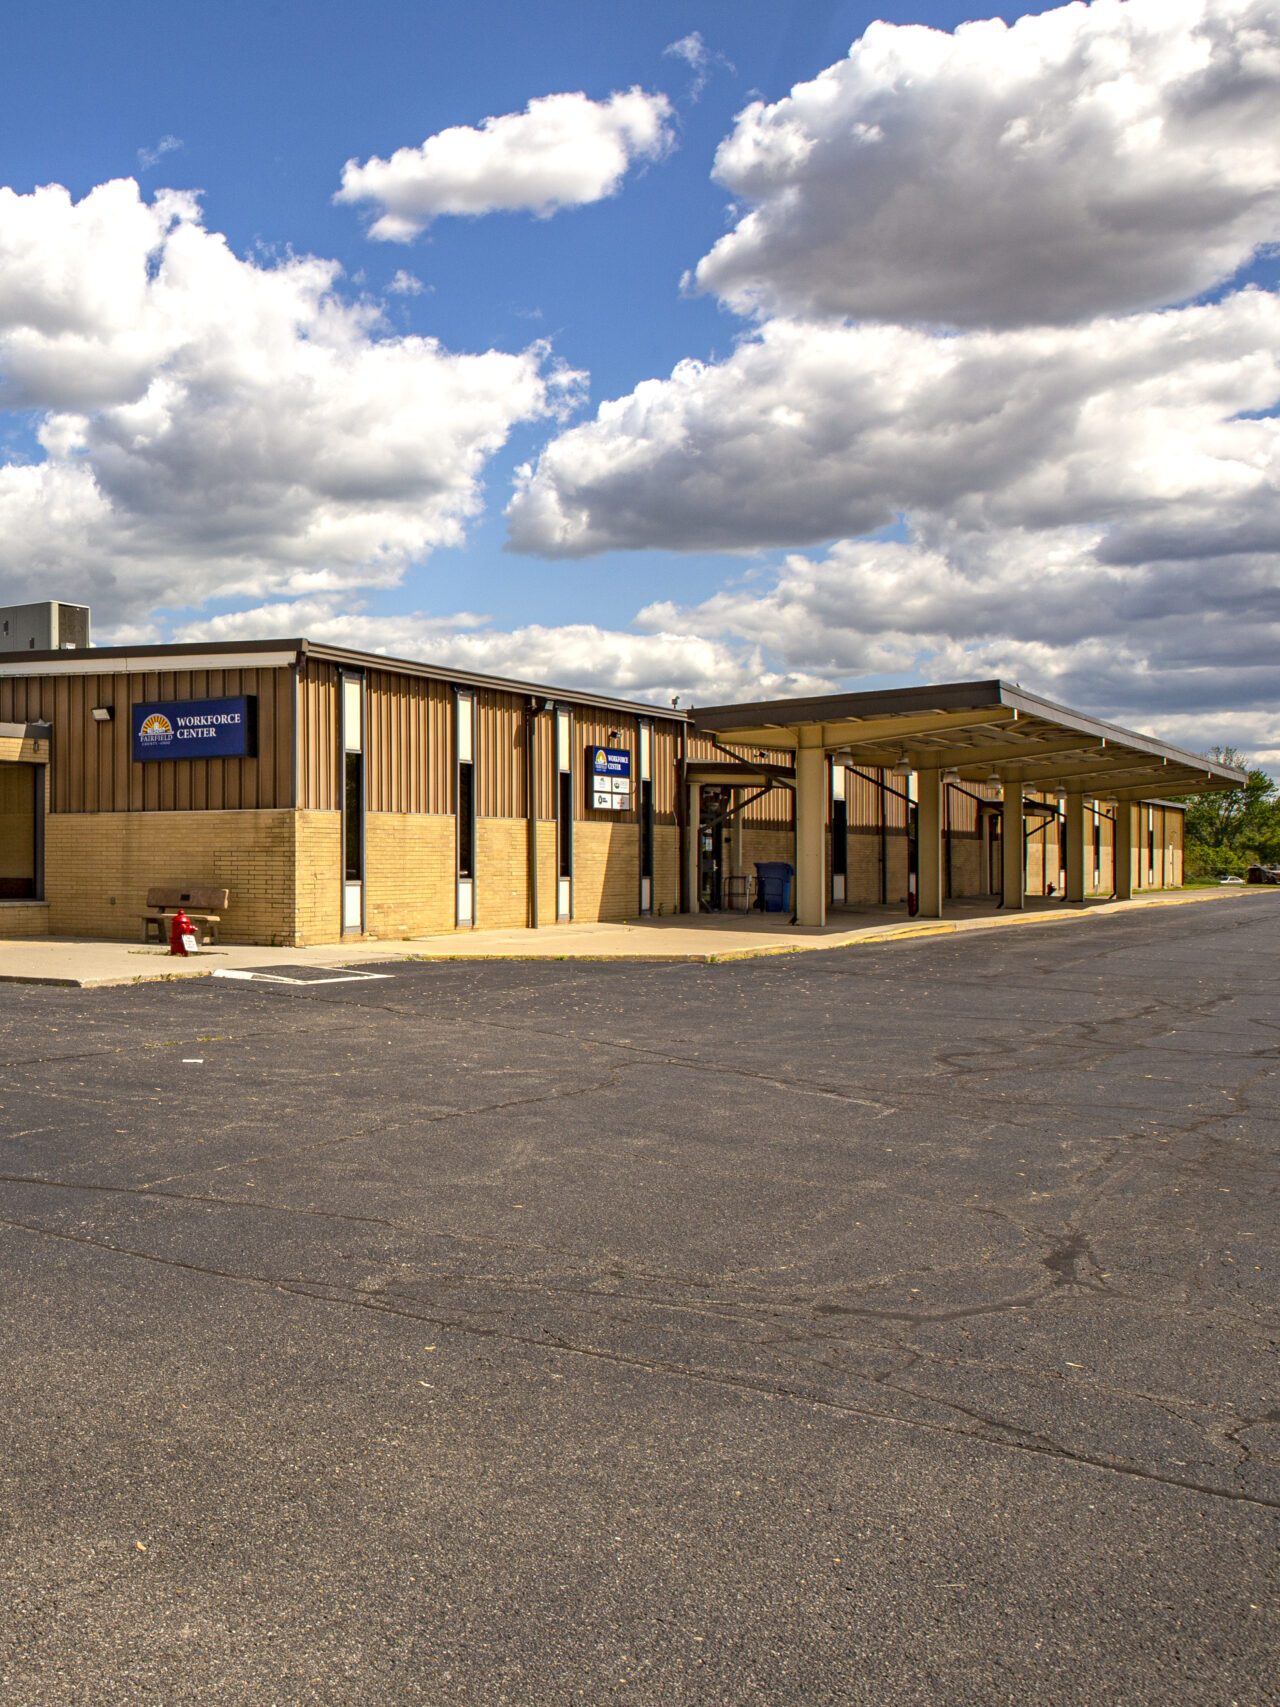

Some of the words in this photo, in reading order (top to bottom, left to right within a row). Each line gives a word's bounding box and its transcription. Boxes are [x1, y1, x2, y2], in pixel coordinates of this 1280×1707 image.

[176, 713, 241, 727] WORKFORCE
[140, 734, 173, 743] FAIRFIELD
[176, 727, 217, 739] CENTER
